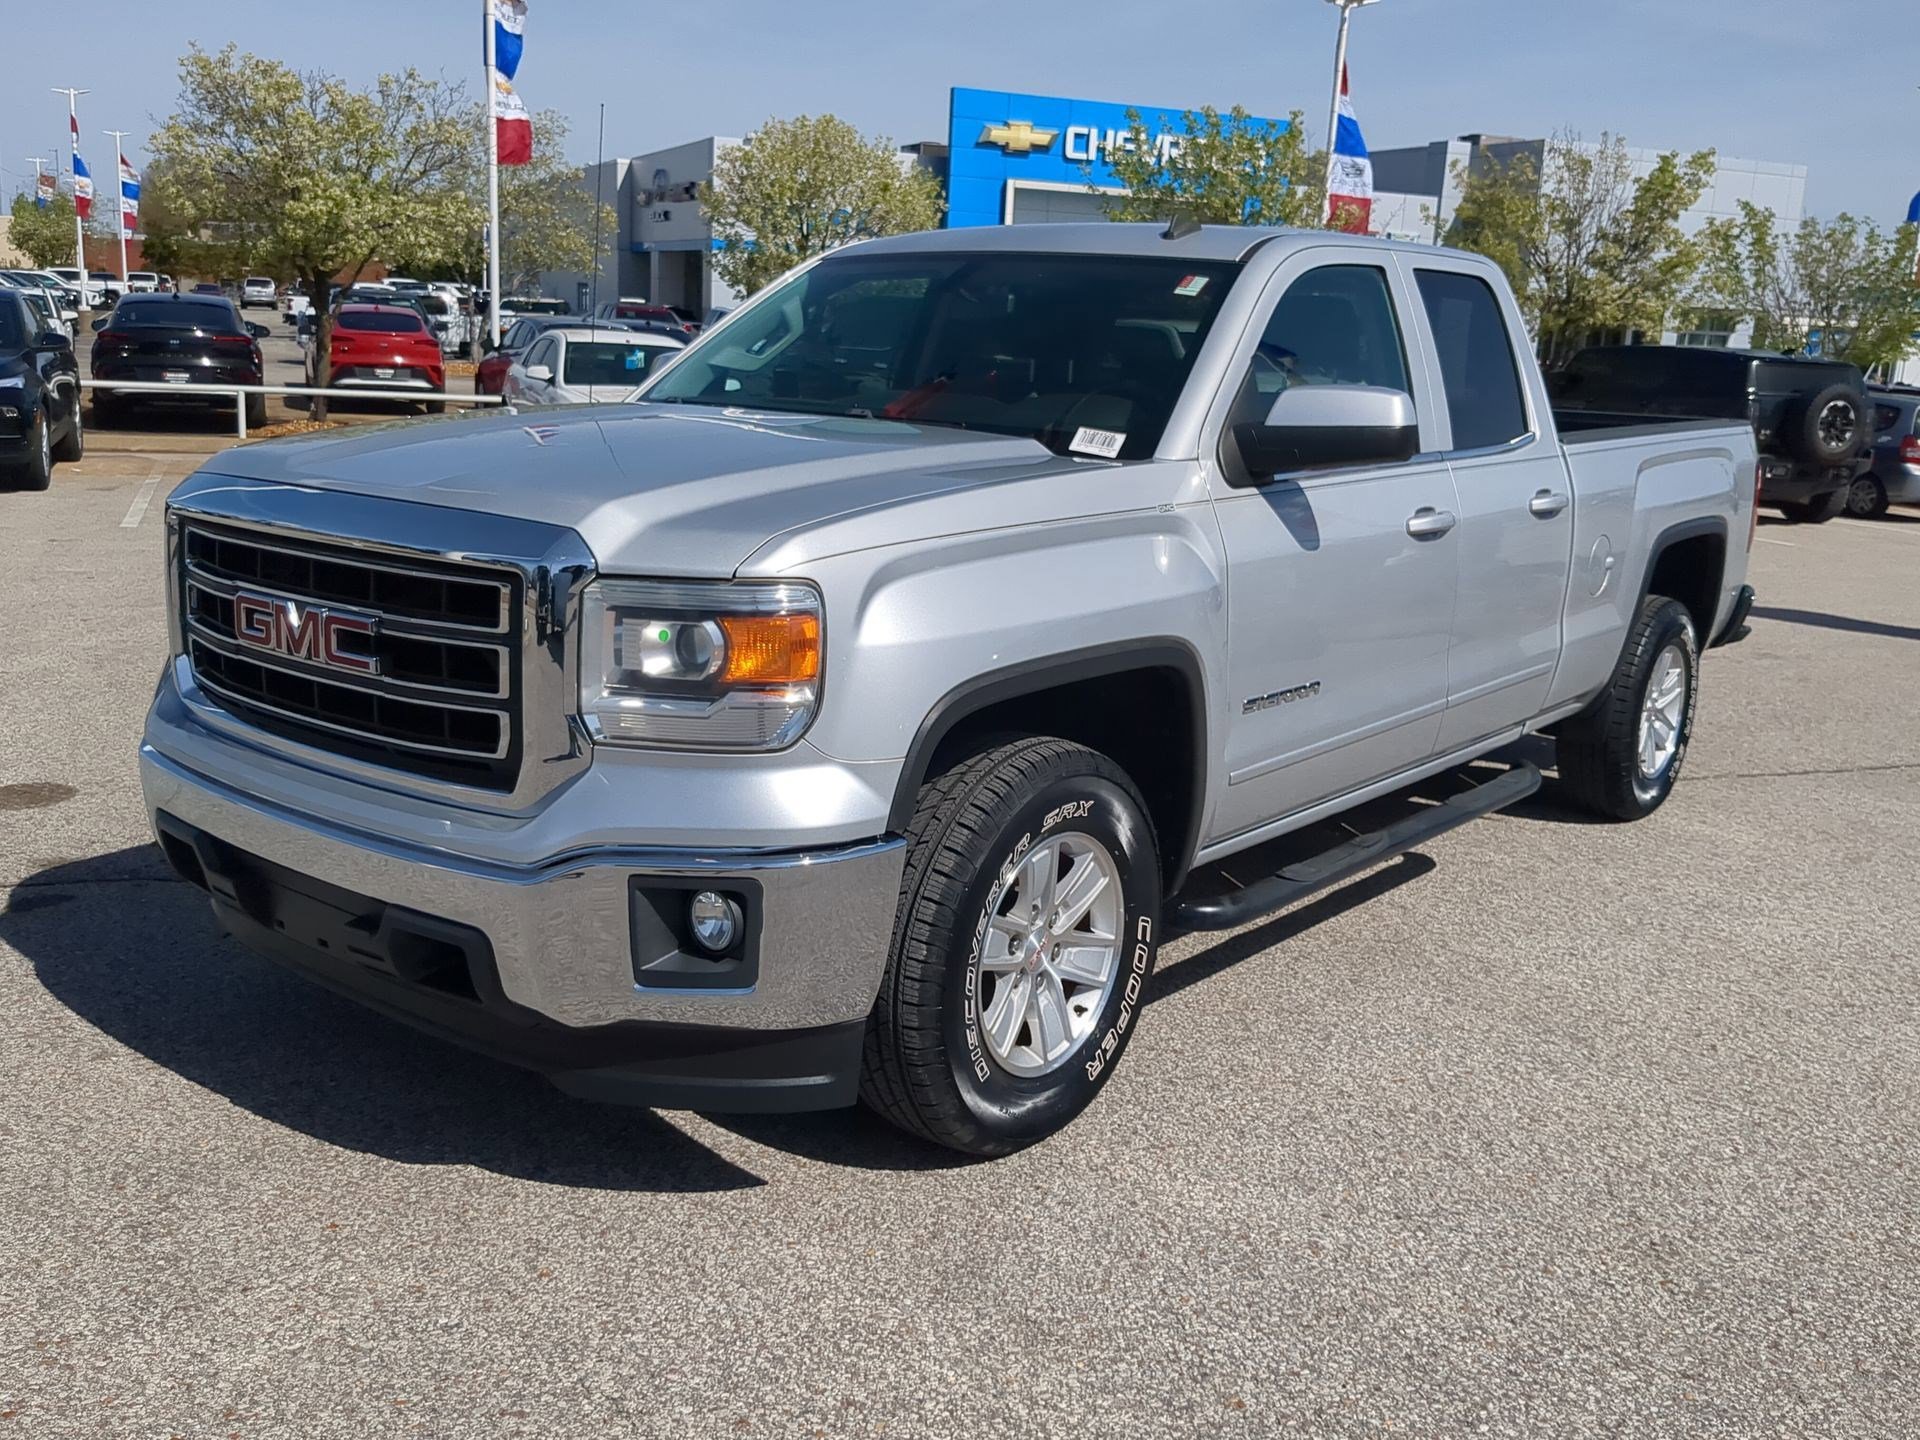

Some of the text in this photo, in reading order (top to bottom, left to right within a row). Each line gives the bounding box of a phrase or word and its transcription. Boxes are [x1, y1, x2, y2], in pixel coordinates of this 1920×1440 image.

[234, 590, 380, 675] GMC
[1242, 680, 1321, 715] SIERRA
[964, 832, 1031, 1083] DISCOVERER
[1041, 800, 1095, 833] SRX
[1085, 916, 1152, 1082] COOPER
